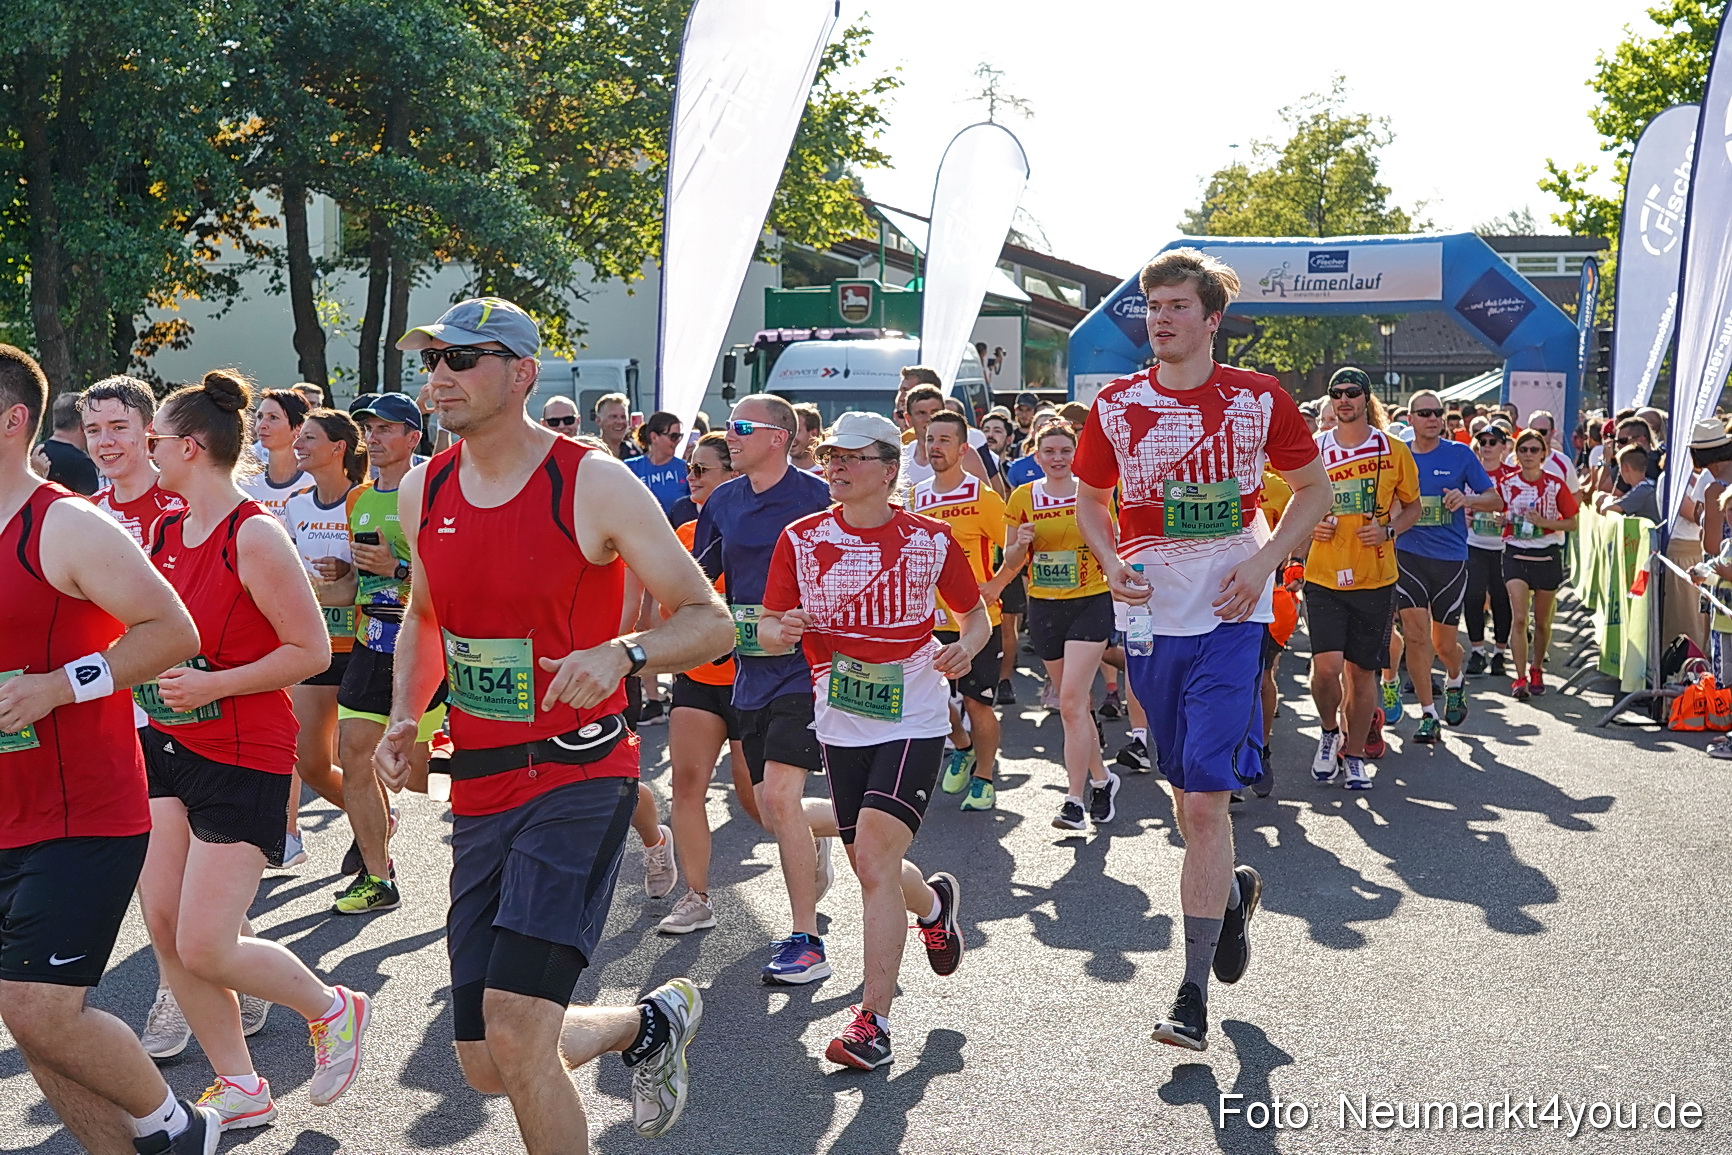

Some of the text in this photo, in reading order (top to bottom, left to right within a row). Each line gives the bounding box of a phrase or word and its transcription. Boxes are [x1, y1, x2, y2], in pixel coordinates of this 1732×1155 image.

[1294, 273, 1383, 291] firmenlauf
[1122, 295, 1148, 314] Fisc
[1358, 459, 1394, 475] BÖGL
[942, 506, 980, 519] BÖGL
[1033, 510, 1061, 521] MAX
[1167, 506, 1175, 527] RUN
[1177, 500, 1230, 521] 1112
[1231, 501, 1239, 527] 2022
[1181, 521, 1225, 529] Neu Florian
[1037, 564, 1069, 577] 1644
[453, 661, 515, 695] 1154
[831, 677, 839, 698] RUN
[517, 672, 529, 710] 2022
[841, 676, 891, 703] 1114
[484, 695, 518, 705] Manfred
[837, 692, 864, 706] Federsel
[864, 701, 892, 711] Claudia
[891, 687, 900, 714] 2022
